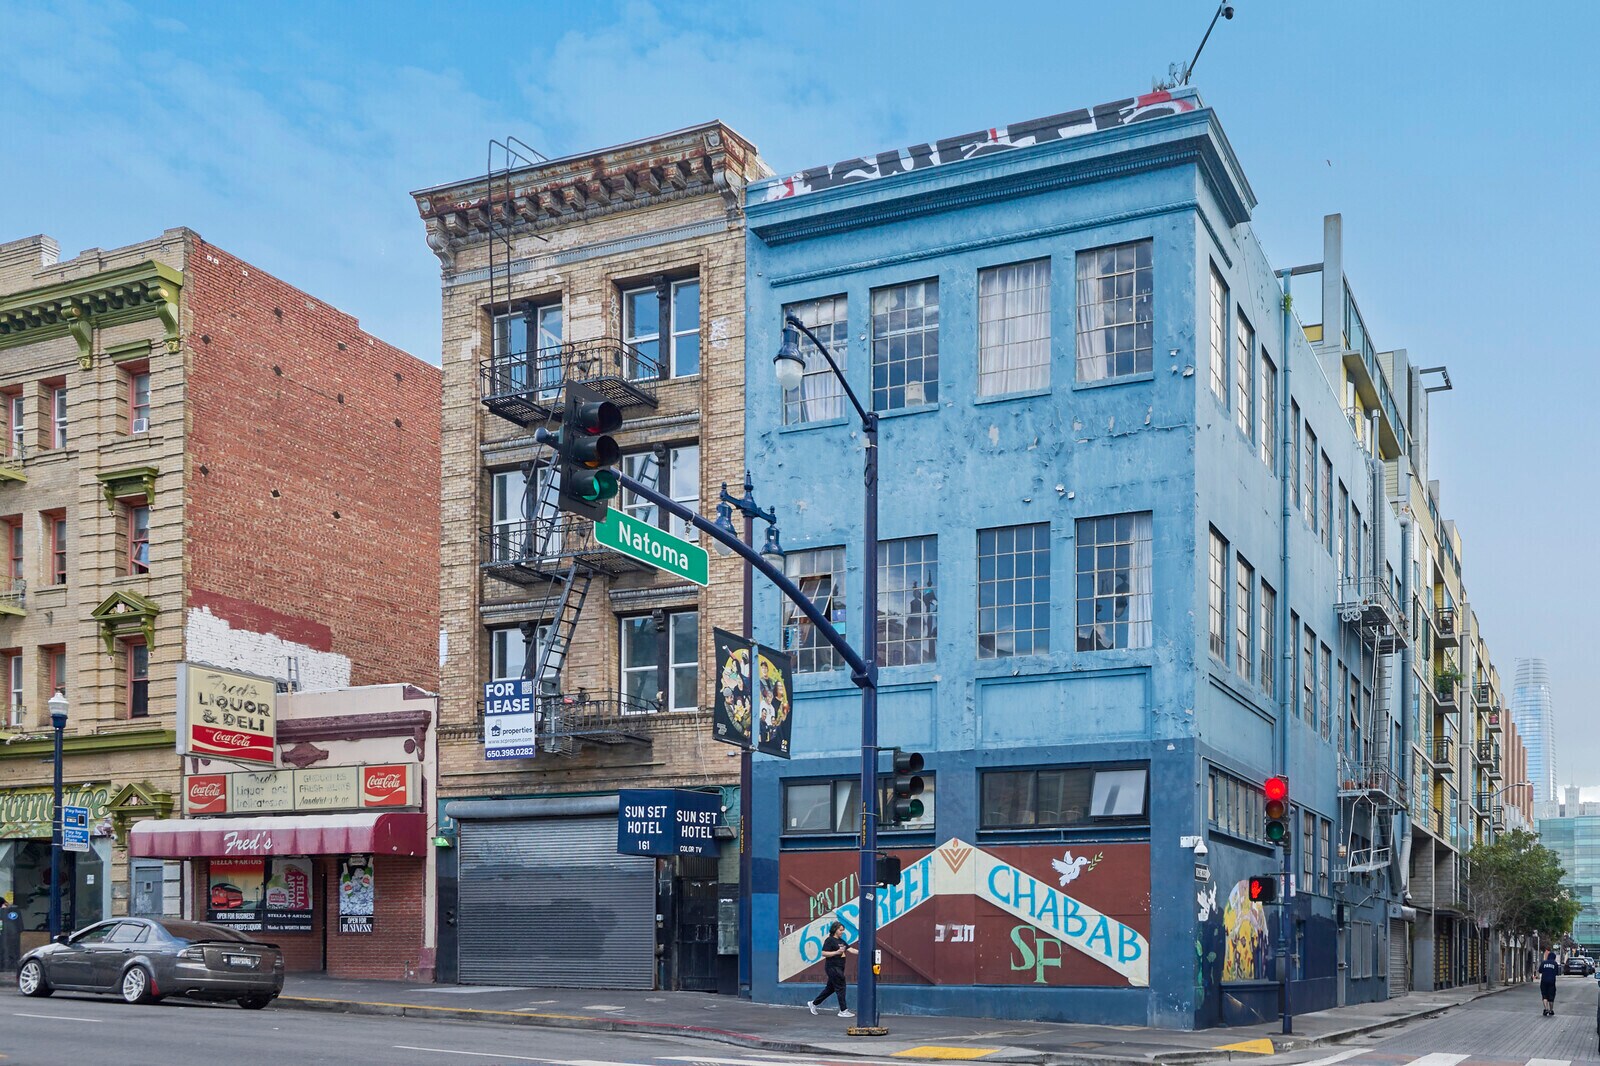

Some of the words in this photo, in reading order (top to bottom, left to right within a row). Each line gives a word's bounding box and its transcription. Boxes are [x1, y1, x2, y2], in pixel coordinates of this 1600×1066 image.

[618, 520, 689, 571] Natoma
[485, 683, 515, 698] FOR
[198, 691, 271, 717] LIQUOR
[486, 697, 530, 714] LEASE
[202, 709, 219, 724] &
[223, 712, 265, 732] DELI
[212, 731, 252, 747] Coca-Cola
[502, 727, 533, 736] properties
[486, 747, 534, 758] 650.398.0282
[366, 773, 401, 789] Coca-Cola
[190, 782, 222, 797] Coca-Cola
[624, 805, 645, 818] SUN
[647, 805, 667, 818] SET
[676, 810, 697, 823] SUN
[698, 812, 717, 824] SET
[627, 821, 663, 834] HOTEL
[681, 825, 713, 838] HOTEL
[223, 831, 273, 855] Fred's
[638, 840, 650, 850] 161
[679, 845, 695, 853] COLOR
[287, 874, 296, 909] ARTOIS
[296, 875, 305, 908] STELLA
[216, 912, 227, 920] OPEN
[227, 912, 235, 920] FOR
[834, 855, 932, 946] SREET
[987, 864, 1142, 965] CHABAB
[1010, 924, 1062, 984] SF
